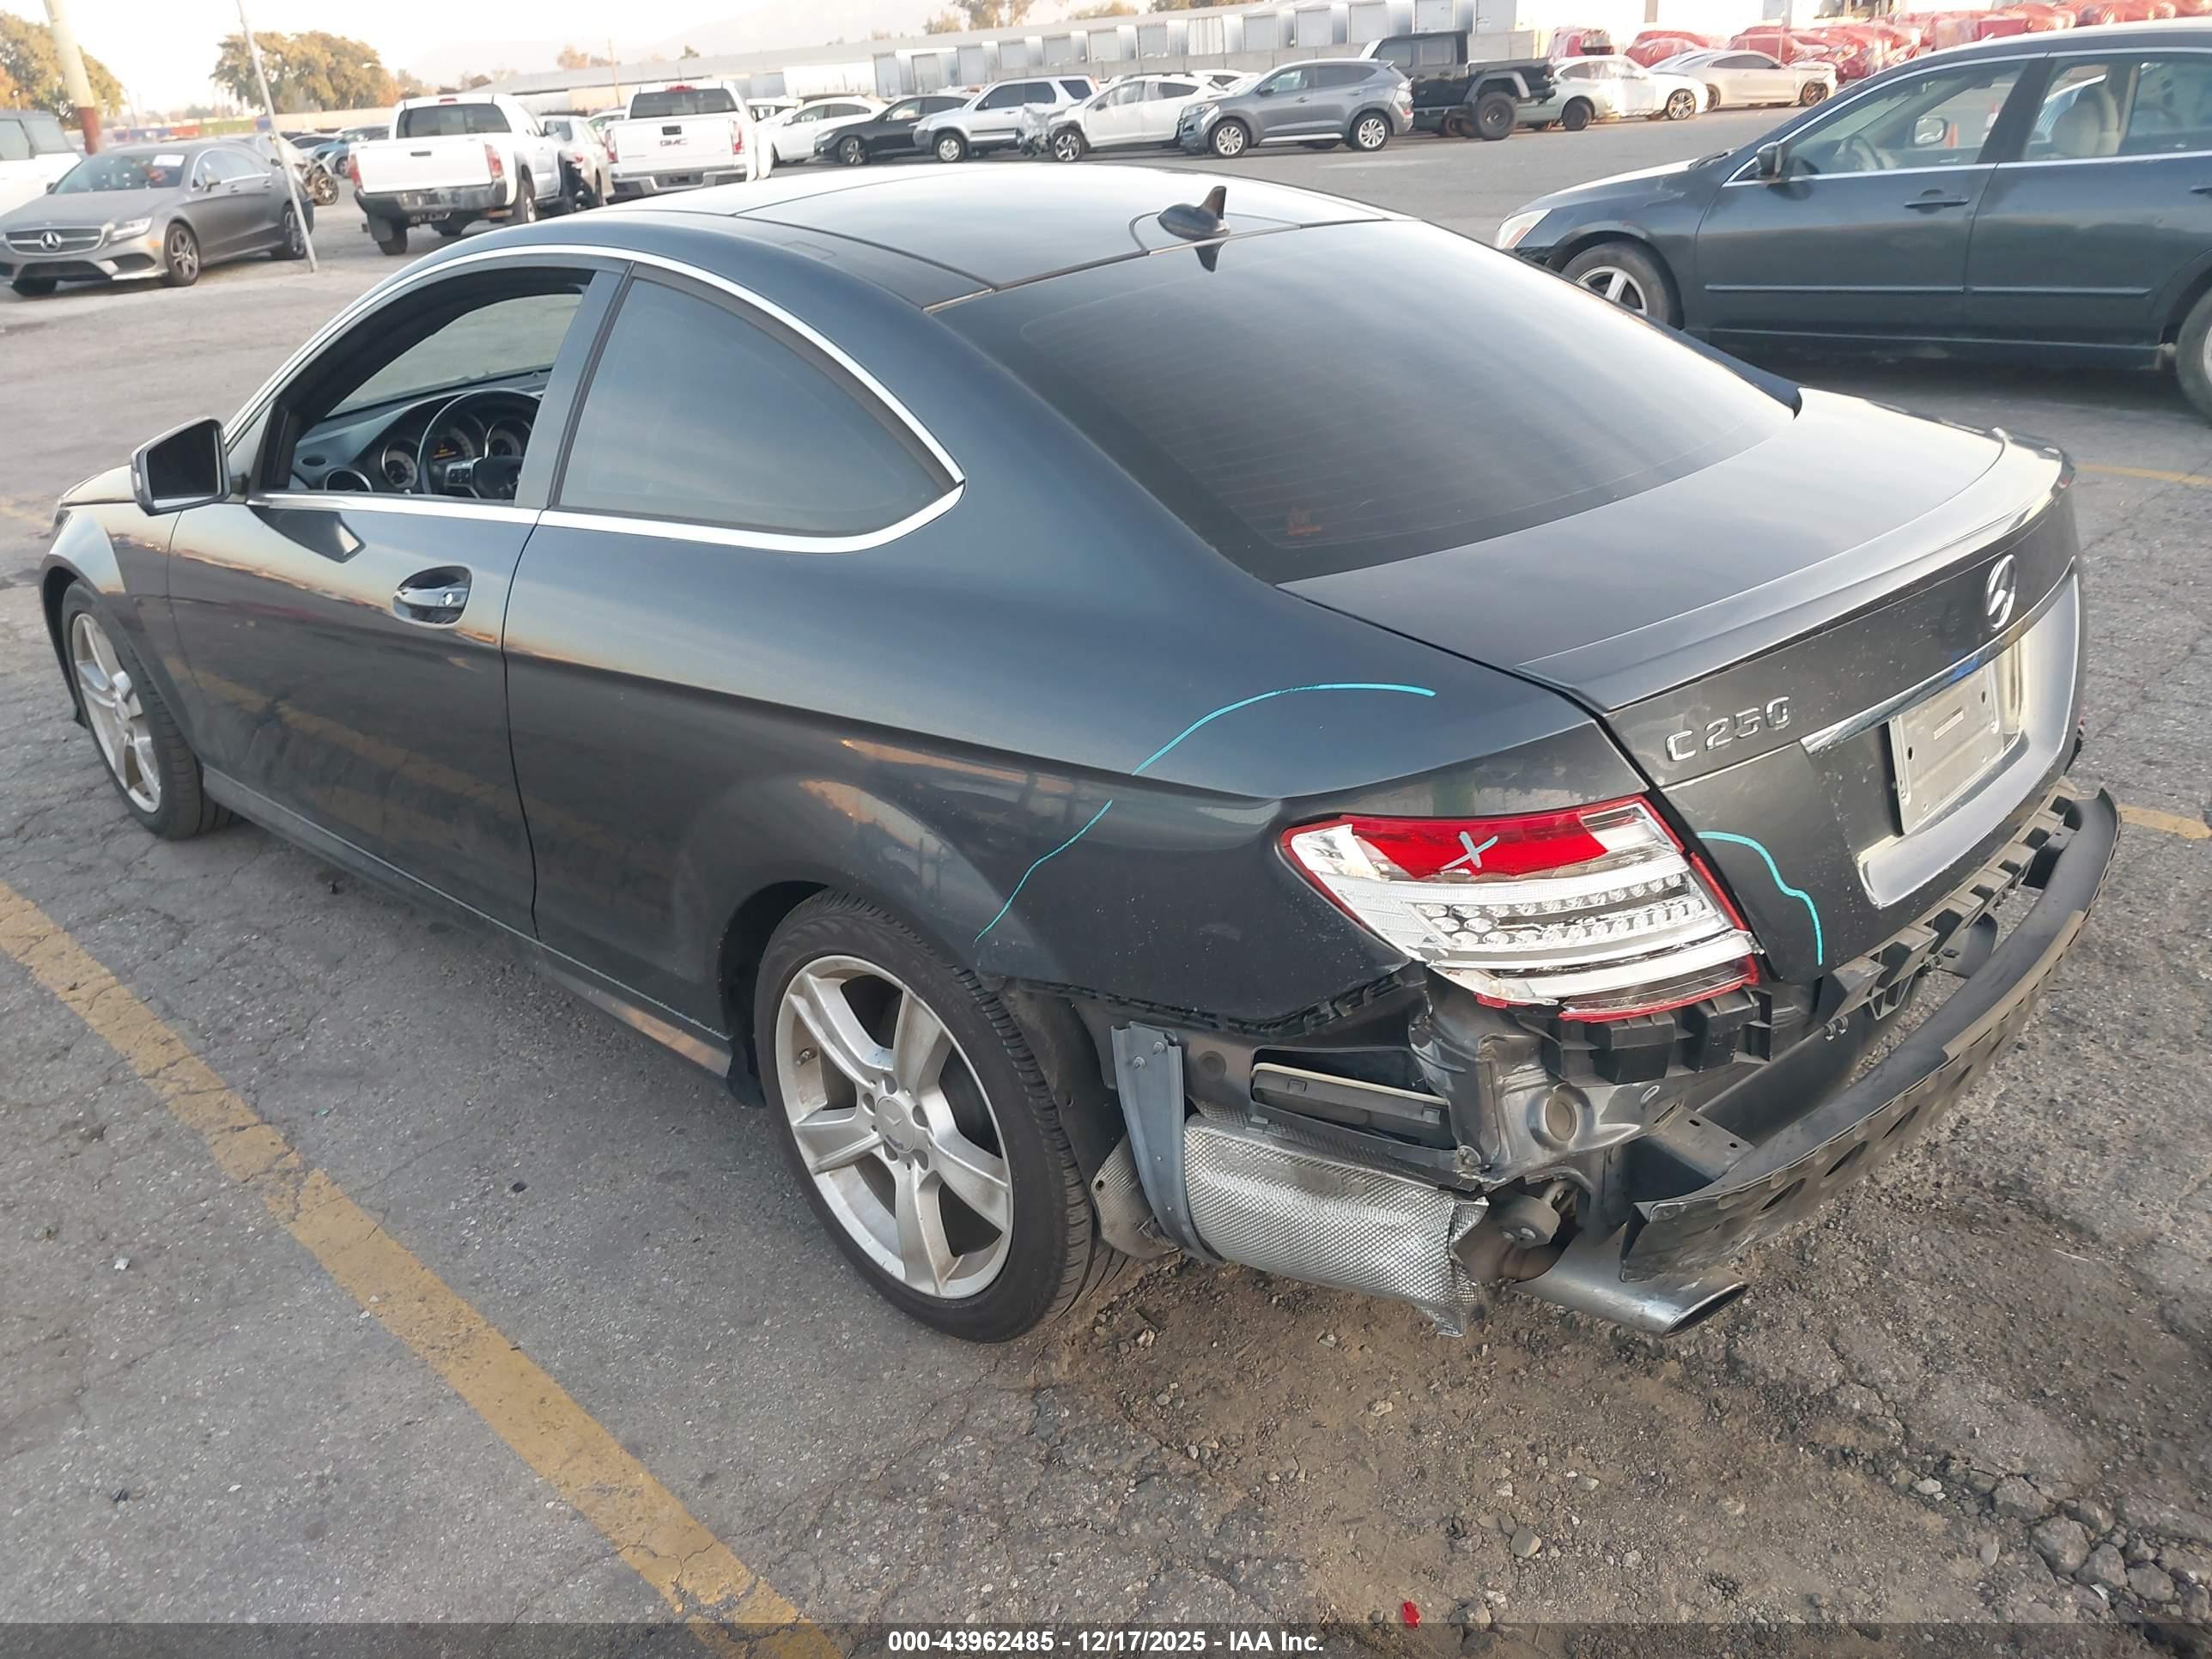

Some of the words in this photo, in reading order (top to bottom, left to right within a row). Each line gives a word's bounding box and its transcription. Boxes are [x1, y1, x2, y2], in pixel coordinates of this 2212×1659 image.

[659, 137, 689, 147] GMC
[1666, 730, 1697, 762] C
[1705, 696, 1790, 751] 250
